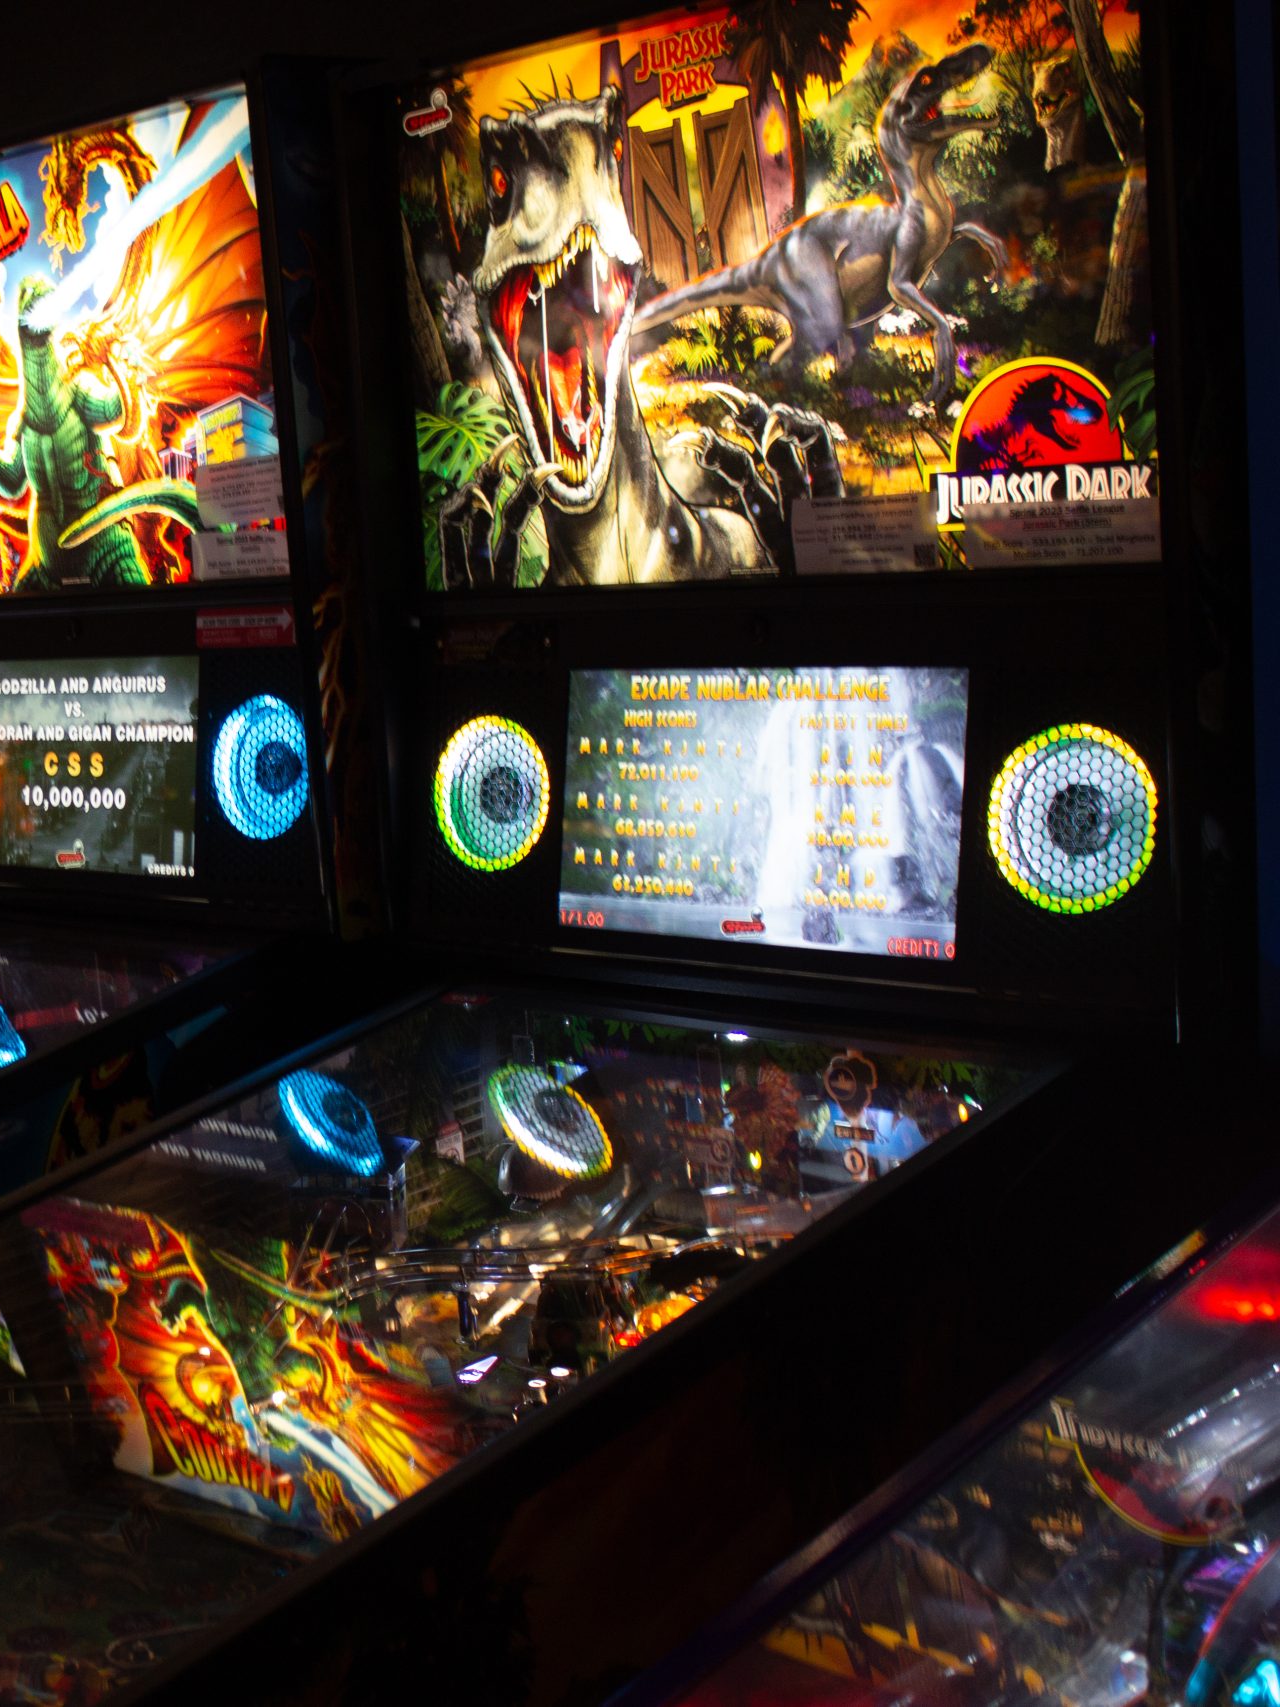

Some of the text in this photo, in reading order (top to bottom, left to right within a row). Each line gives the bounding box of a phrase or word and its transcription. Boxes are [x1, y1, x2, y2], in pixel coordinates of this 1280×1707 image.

[634, 19, 730, 83] JURASSIC
[661, 61, 717, 107] PARK
[936, 462, 1153, 525] JURASSIC PARK
[60, 677, 88, 694] AND
[93, 676, 166, 694] ANGUIRUS
[631, 675, 891, 702] ESCAPE NUBLAR CHALLENGE
[64, 701, 85, 718] VS.
[624, 709, 697, 729] HIGH SCORES
[800, 712, 908, 731] FASTEST TIMES
[36, 725, 64, 742] AND
[68, 726, 111, 742] GIGAN
[116, 726, 194, 743] CHAMPION
[22, 785, 126, 813] 10,000,000
[147, 864, 186, 877] CREDITS
[887, 936, 956, 961] CREDITS 0
